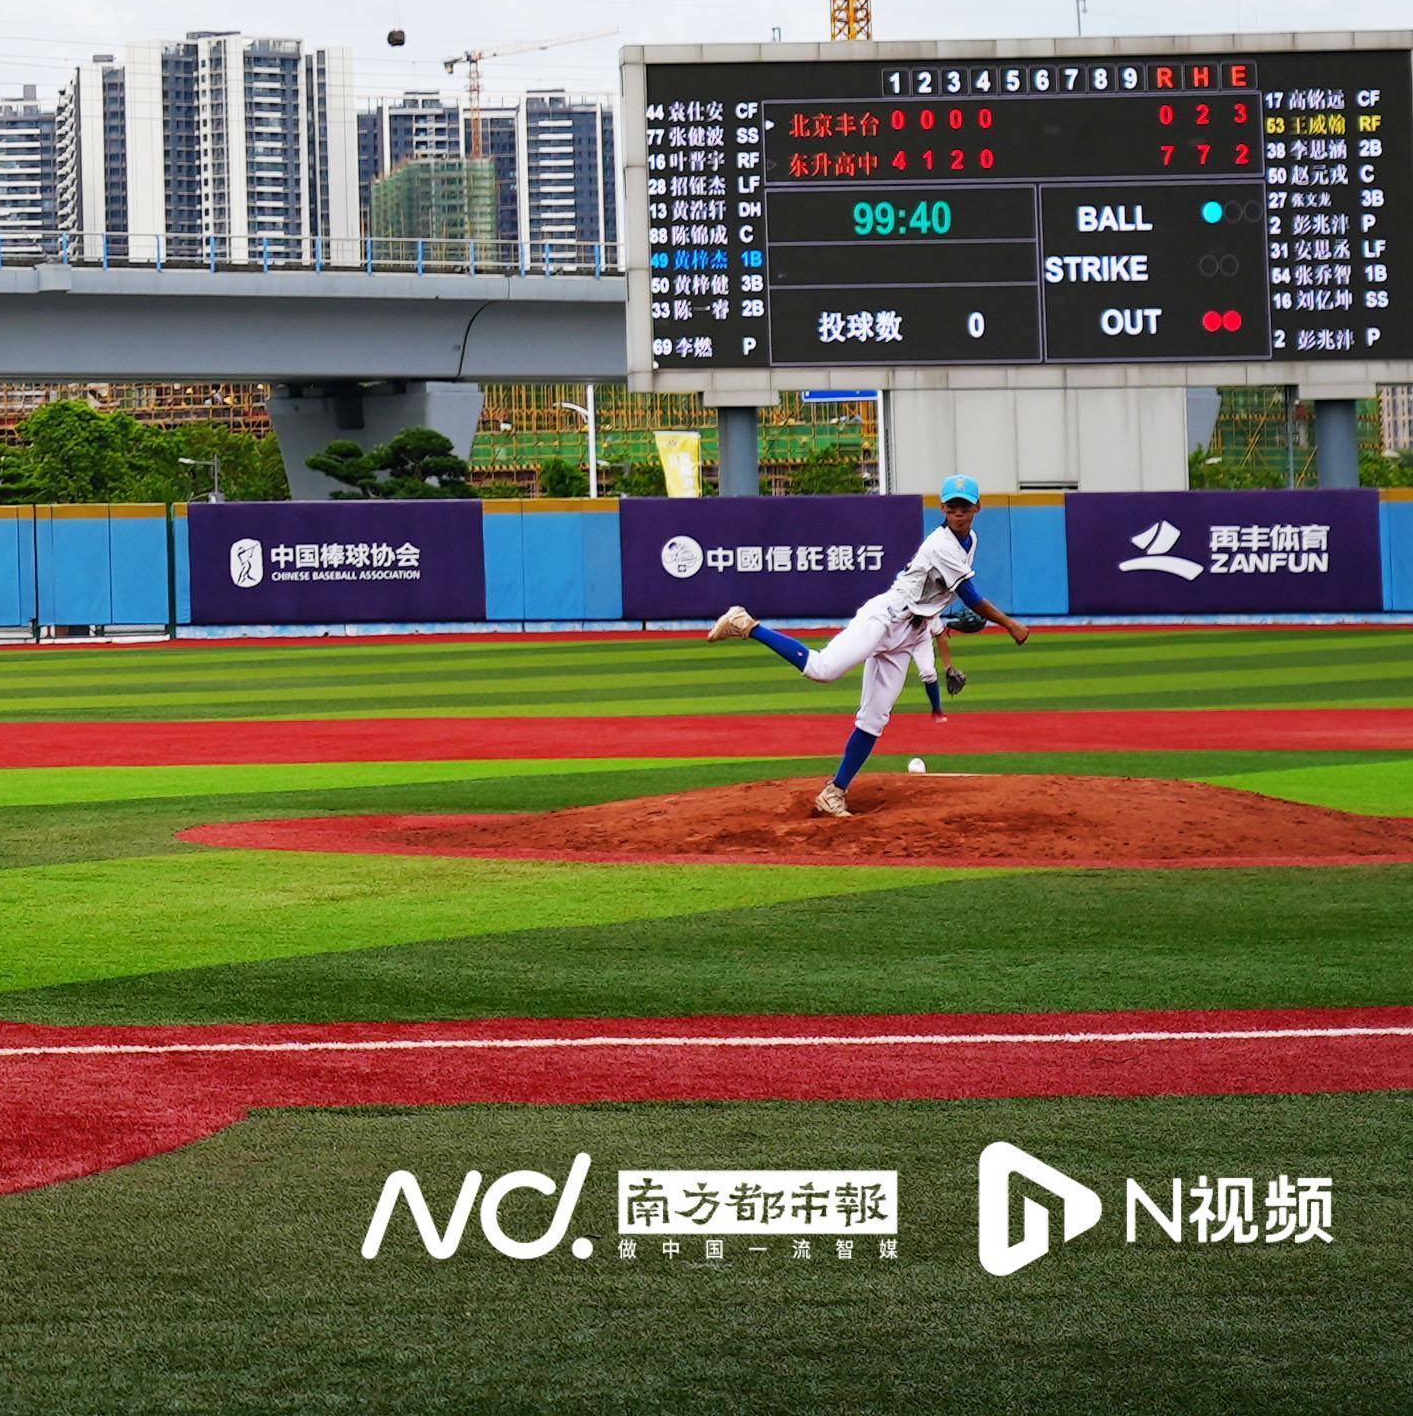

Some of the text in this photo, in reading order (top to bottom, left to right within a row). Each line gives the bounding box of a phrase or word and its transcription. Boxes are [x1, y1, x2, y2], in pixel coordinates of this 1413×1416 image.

[889, 66, 1246, 92] 1 2 3 4 5 6 7 8 9 R H E
[1265, 92, 1283, 109] 17
[1357, 90, 1380, 107] CF
[646, 104, 664, 120] 44
[735, 102, 758, 119] CF
[789, 103, 1248, 138] 北京丰台 0 0 0 0 0 2 3
[1360, 115, 1381, 132] RF
[646, 129, 664, 145] 77
[736, 127, 759, 144] SS
[1267, 143, 1286, 159] 38
[1359, 139, 1382, 157] 2B
[648, 154, 666, 170] 16
[737, 152, 759, 168] RF
[789, 143, 1249, 177] 东升高中 4 1 2 0 7 7 2
[1361, 165, 1374, 183] C
[648, 178, 666, 195] 28
[738, 176, 760, 193] LF
[1269, 192, 1287, 208] 27
[1362, 189, 1384, 207] 3B
[649, 203, 667, 219] 13
[739, 202, 761, 217] DH
[853, 201, 952, 235] 99:40
[1078, 205, 1153, 232] BALL
[1270, 216, 1281, 234] 2
[1363, 214, 1376, 232] P
[649, 227, 667, 244] 88
[740, 225, 753, 243] C
[651, 252, 668, 268] 49
[741, 250, 762, 267] 1B
[1271, 243, 1288, 259] 31
[1364, 240, 1386, 257] LF
[1044, 255, 1149, 283] STRIKE
[1365, 264, 1388, 282] 1B
[651, 277, 670, 293] 50
[741, 275, 763, 292] 3B
[652, 302, 670, 318] 33
[742, 300, 764, 316] 2B
[1273, 292, 1292, 309] 16
[1366, 291, 1389, 308] SS
[819, 311, 985, 343] 投球数 0
[1101, 308, 1162, 336] OUT
[653, 339, 672, 355] 69
[743, 337, 757, 355] P
[1274, 329, 1286, 348] 2
[1367, 327, 1381, 346] P
[1210, 524, 1331, 552] 再丰体育
[270, 542, 420, 569] 中国棒球协会
[706, 545, 884, 572] 中國信託銀行
[1210, 552, 1329, 573] ZANFUN
[272, 569, 420, 581] CHINESE BASEBALL ASSOCIATION
